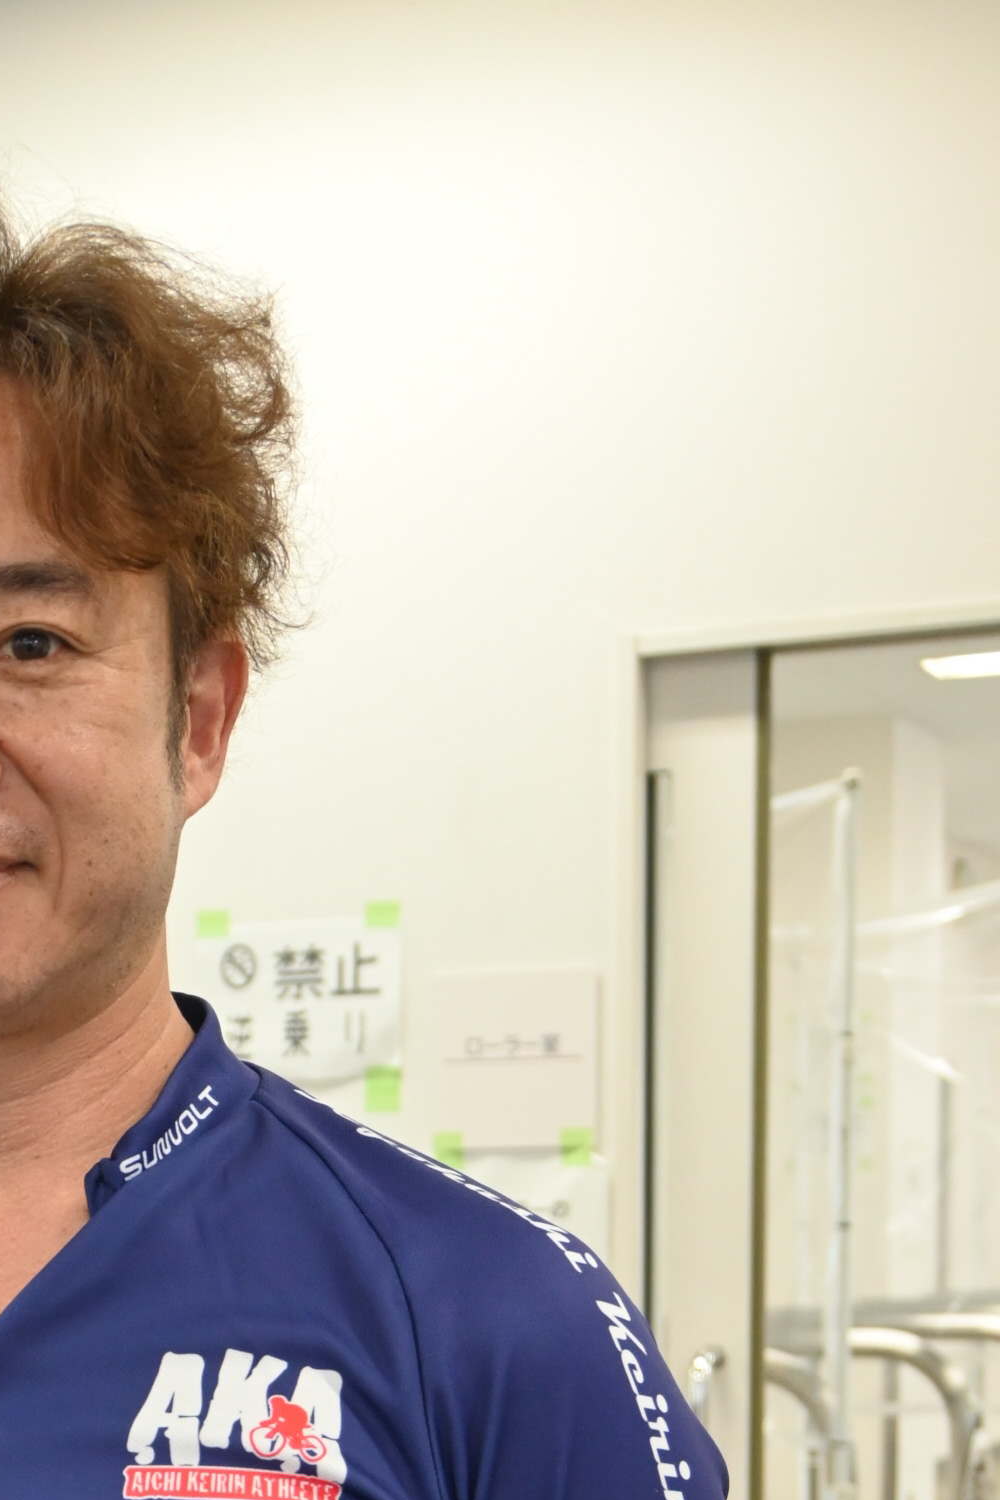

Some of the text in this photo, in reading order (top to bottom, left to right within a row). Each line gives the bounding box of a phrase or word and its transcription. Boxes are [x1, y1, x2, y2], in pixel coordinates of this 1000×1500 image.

[274, 940, 384, 1000] 禁止
[119, 1085, 219, 1181] SUNVOLT
[126, 1348, 348, 1485] AKA
[131, 1470, 182, 1493] AICHI
[186, 1471, 246, 1495] KEIRIN
